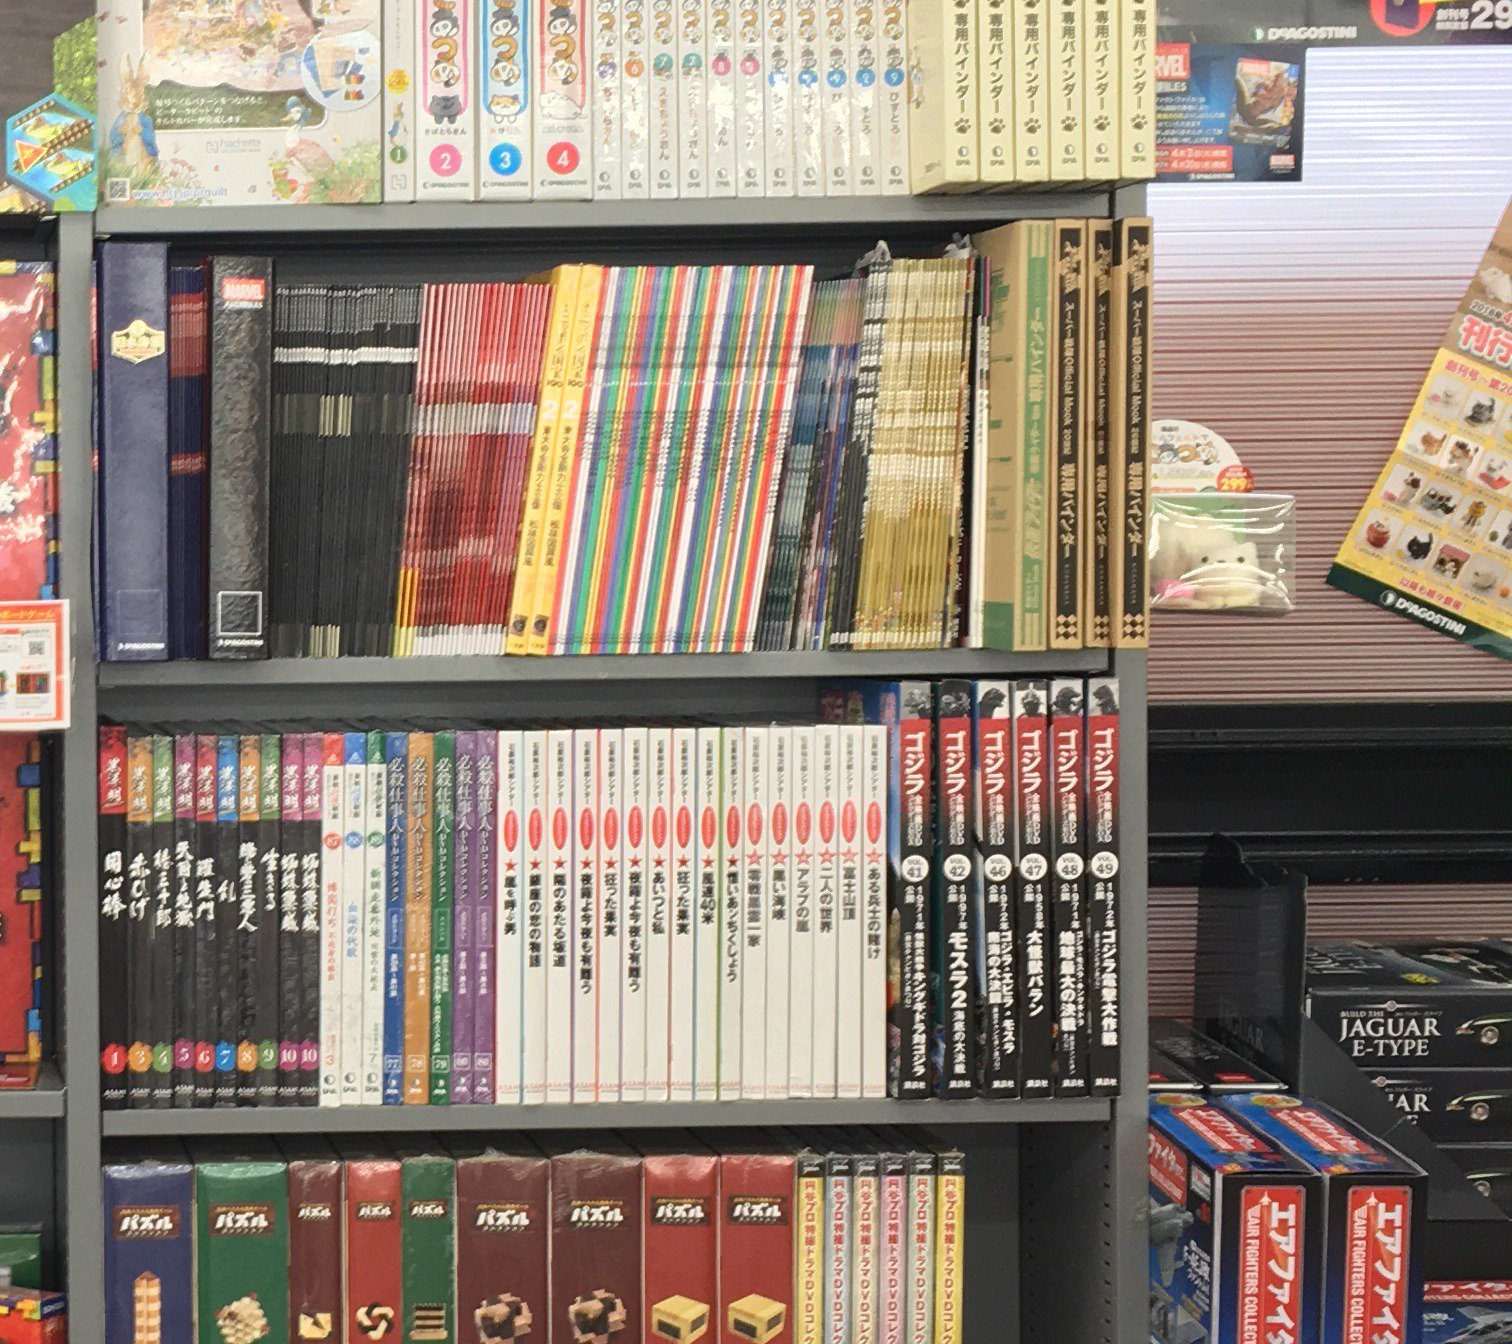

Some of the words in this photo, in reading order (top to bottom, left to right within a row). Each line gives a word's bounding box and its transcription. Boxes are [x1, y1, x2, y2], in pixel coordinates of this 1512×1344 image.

[953, 12, 970, 114] 専用バインダー
[988, 12, 1004, 114] 専用バインダー
[1023, 12, 1040, 114] 専用バインダー
[1060, 10, 1077, 112] 専用バインダー
[1093, 9, 1110, 111] 専用バインダー
[1131, 8, 1148, 110] 専用バインダー
[439, 152, 453, 171] 2
[499, 151, 512, 170] 3
[557, 150, 571, 167] 4
[224, 283, 265, 301] MARVEL
[541, 399, 559, 421] 2
[563, 399, 580, 421] 2
[904, 730, 927, 795] ゴジラ
[945, 729, 967, 795] ゴジラ
[983, 729, 1006, 795] ゴジラ
[1020, 729, 1044, 794] ゴジラ
[1057, 728, 1079, 793] ゴジラ
[1093, 727, 1115, 793] ゴジラ
[906, 867, 923, 879] 41
[948, 866, 966, 877] 42
[989, 866, 1007, 878] 46
[1026, 864, 1042, 876] 47
[1063, 863, 1078, 875] 48
[1098, 862, 1113, 875] 49
[128, 852, 151, 921] 赤ひげ
[216, 878, 237, 904] 乱
[819, 867, 833, 934] 二人の世界
[948, 931, 969, 1010] モスラ2
[1339, 1017, 1441, 1043] JAGUAR
[220, 1049, 231, 1065] 7
[280, 1048, 298, 1064] 10
[301, 1048, 318, 1063] 10
[1352, 1038, 1430, 1057] E-TYPE
[119, 1213, 174, 1232] パズル
[214, 1211, 270, 1230] パズル
[297, 1206, 332, 1218] パズル
[358, 1206, 392, 1218] パズル
[1245, 1217, 1261, 1239] AIR
[1352, 1217, 1367, 1240] AIR
[1244, 1239, 1259, 1297] FIGHTERS
[1351, 1240, 1366, 1298] FIGHTERS
